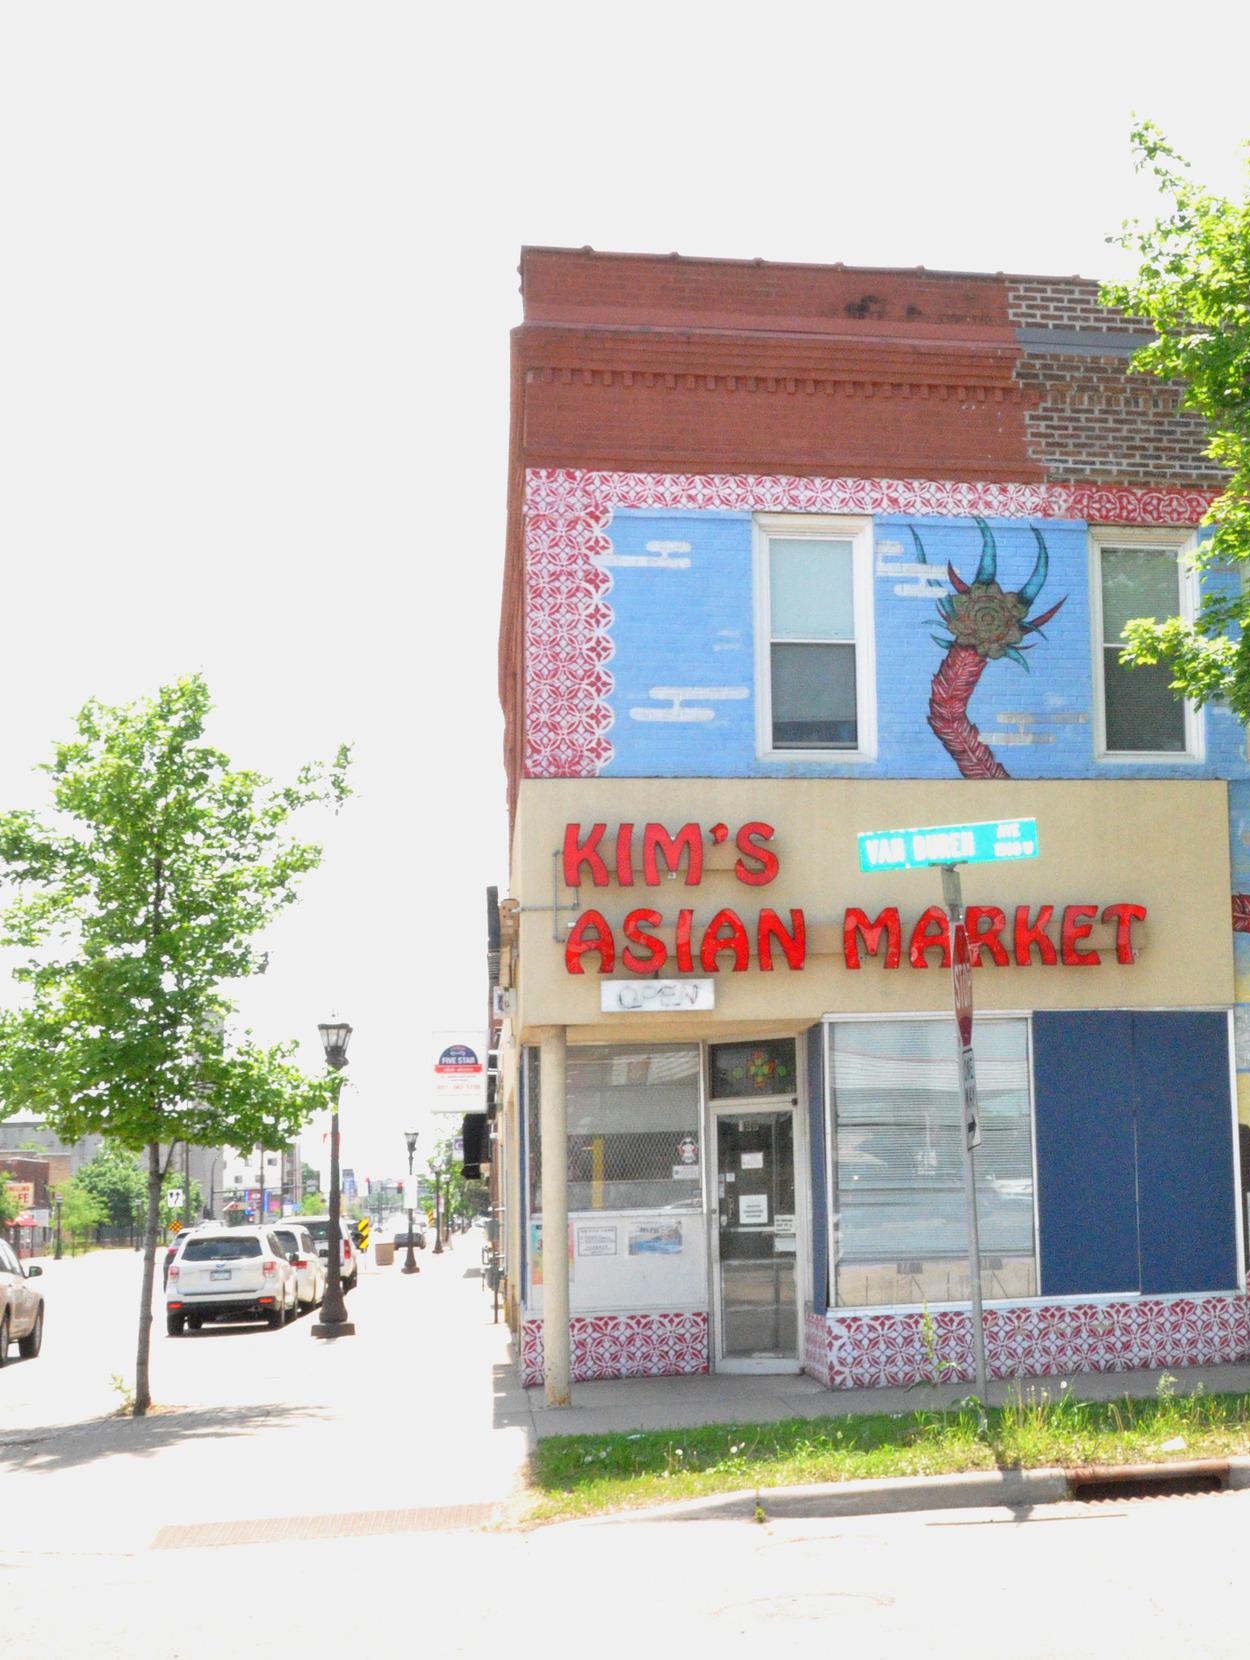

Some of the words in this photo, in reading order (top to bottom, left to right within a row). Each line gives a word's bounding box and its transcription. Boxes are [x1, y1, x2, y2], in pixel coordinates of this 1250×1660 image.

[563, 821, 780, 888] KIM'S
[865, 837, 906, 864] VAN
[912, 831, 976, 861] BUREN
[564, 908, 806, 975] ASIAN
[844, 902, 1148, 970] MARKET
[954, 962, 971, 1010] STOP
[441, 1056, 457, 1064] FIVE
[457, 1056, 476, 1064] STAR
